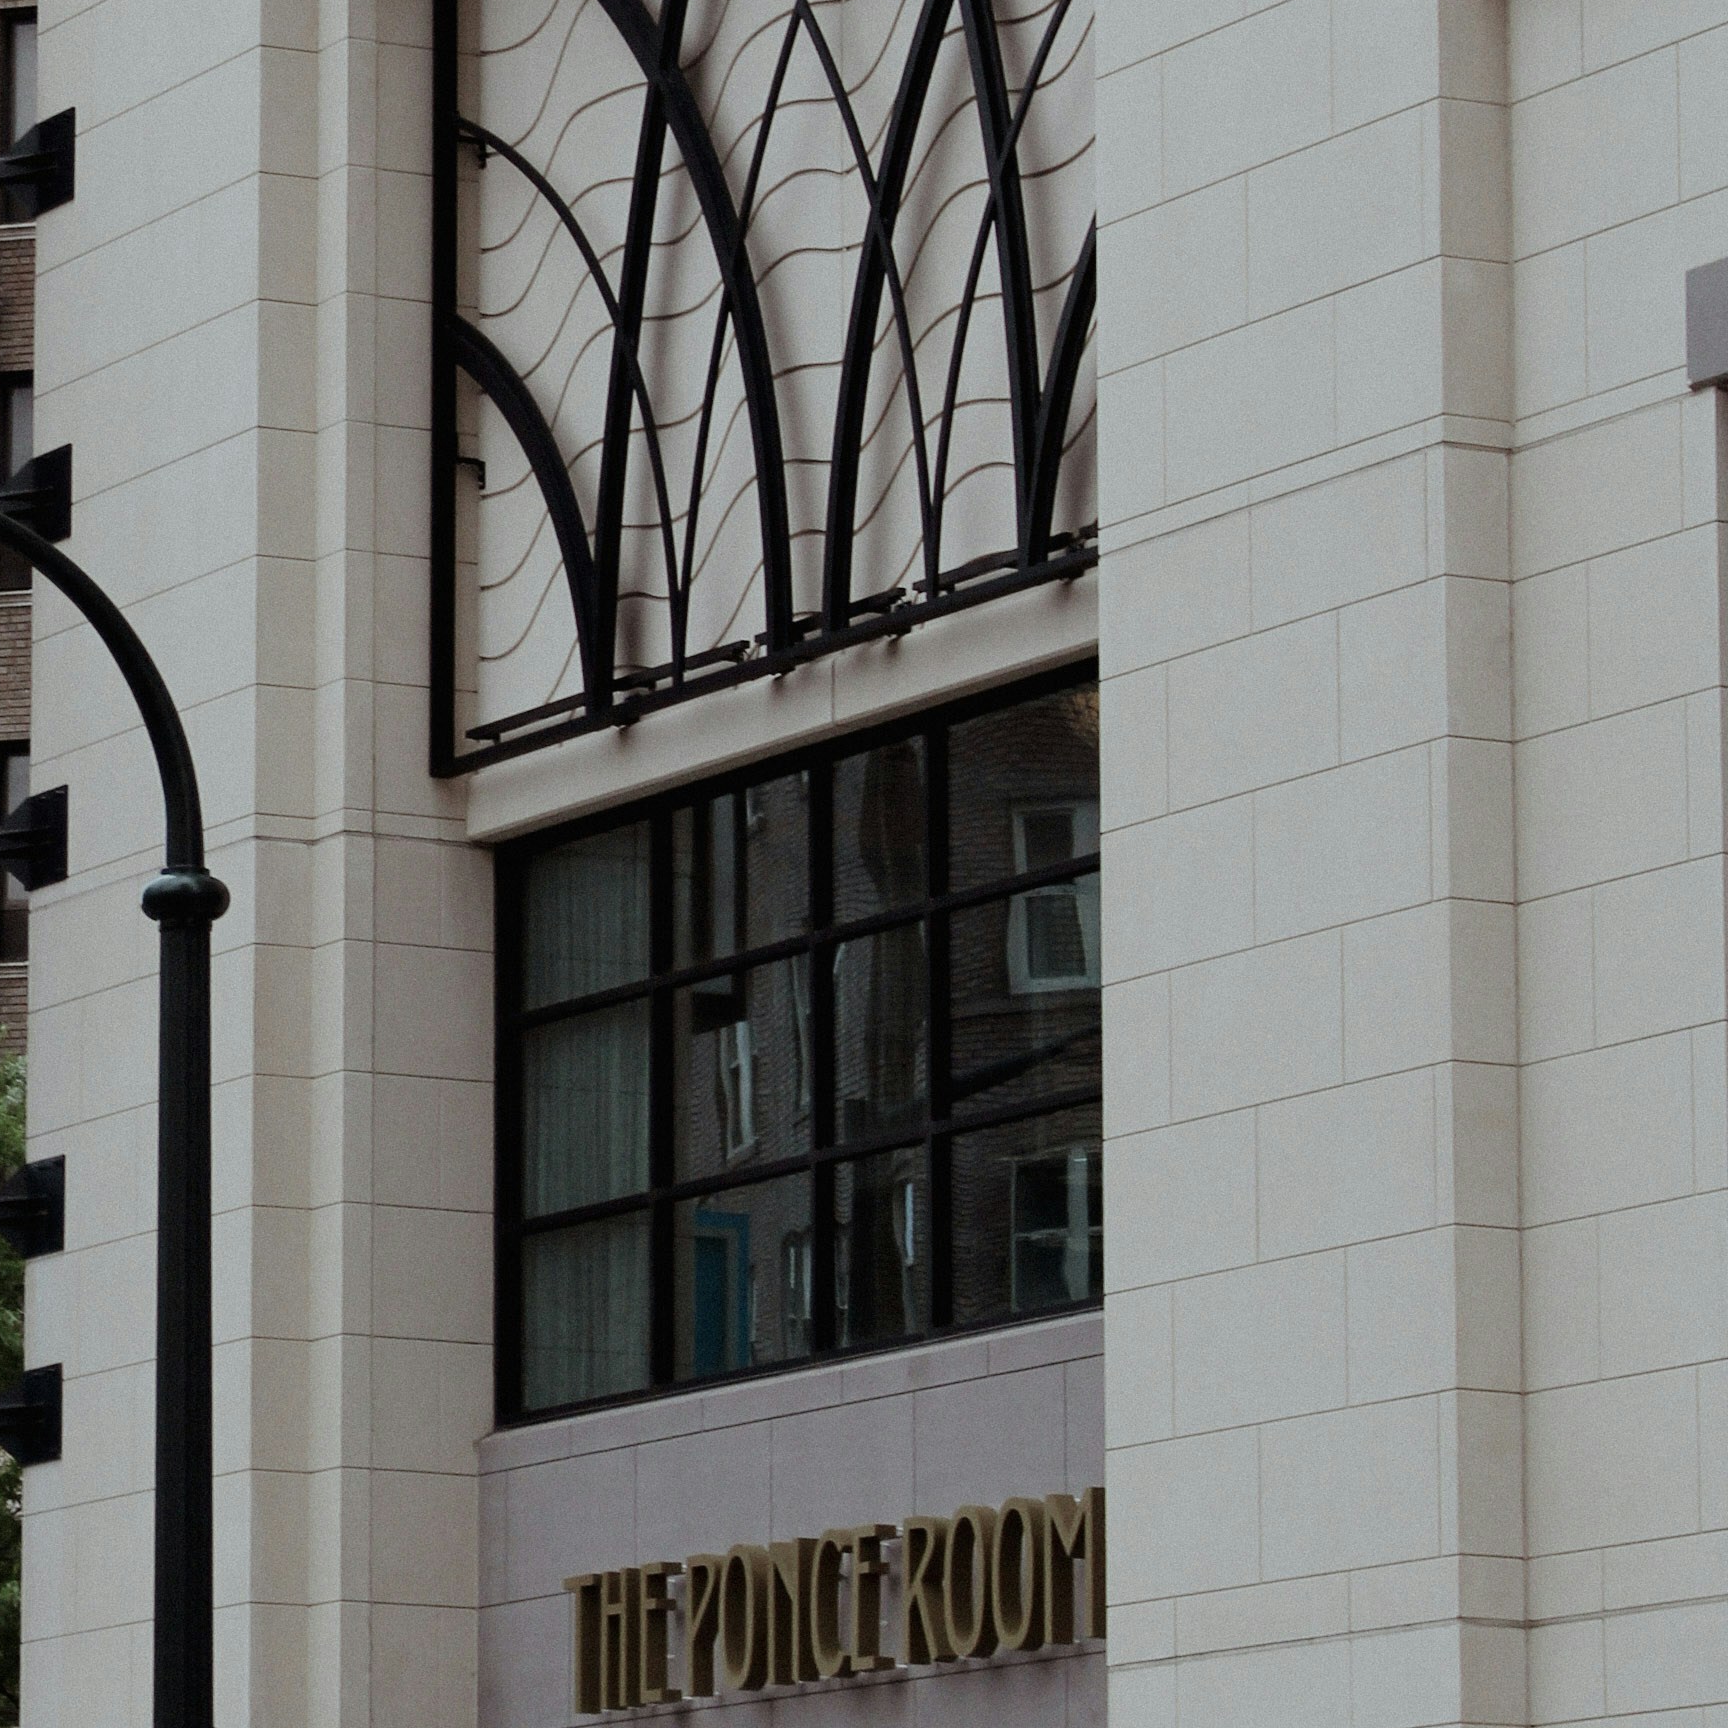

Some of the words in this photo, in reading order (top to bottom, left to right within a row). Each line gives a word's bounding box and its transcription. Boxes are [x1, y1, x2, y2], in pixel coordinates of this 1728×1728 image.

[562, 1560, 685, 1714] THE
[685, 1523, 898, 1698] PONCE
[903, 1485, 1107, 1666] ROOM
